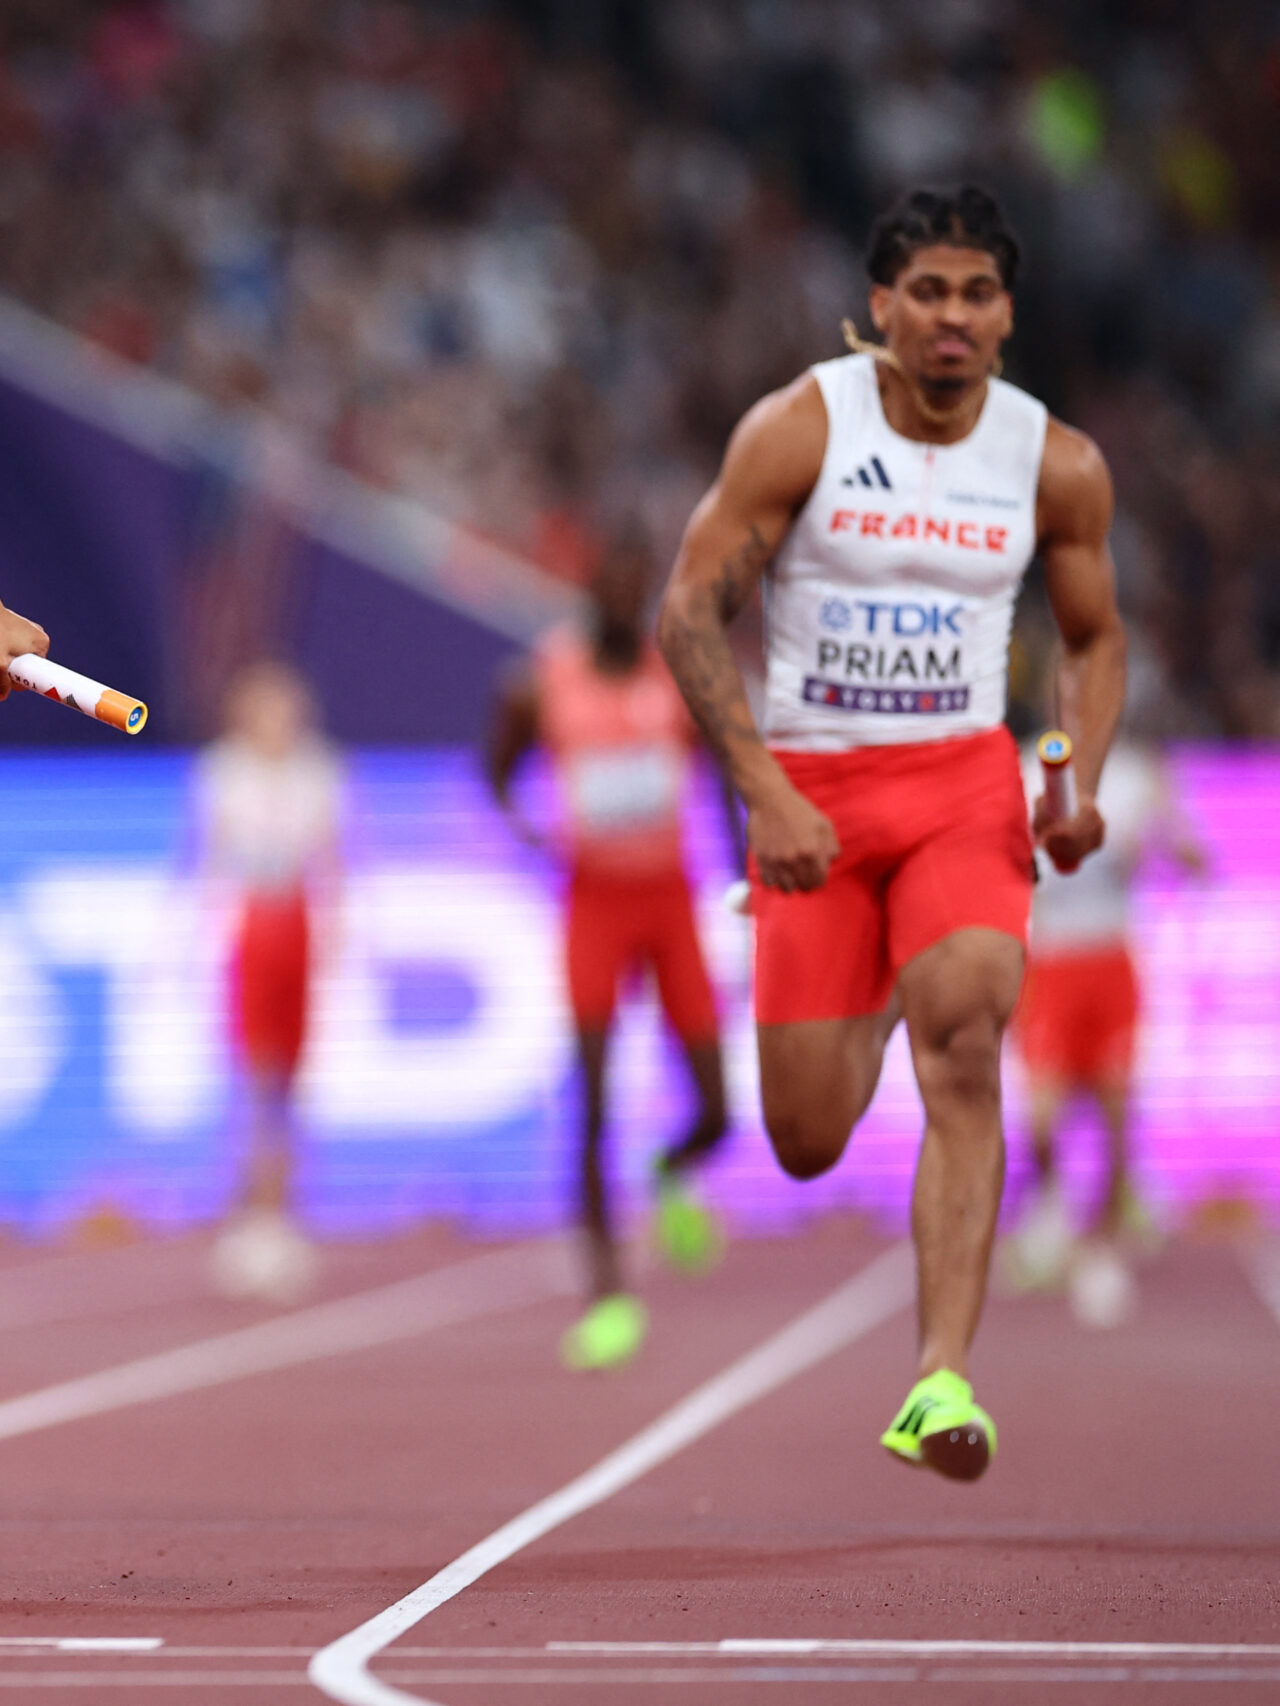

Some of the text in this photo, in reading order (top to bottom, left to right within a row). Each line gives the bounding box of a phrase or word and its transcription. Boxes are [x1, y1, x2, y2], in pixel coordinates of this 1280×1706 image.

[829, 509, 1010, 554] FRANCE
[854, 601, 966, 637] TDK
[818, 639, 961, 679] PRIAM
